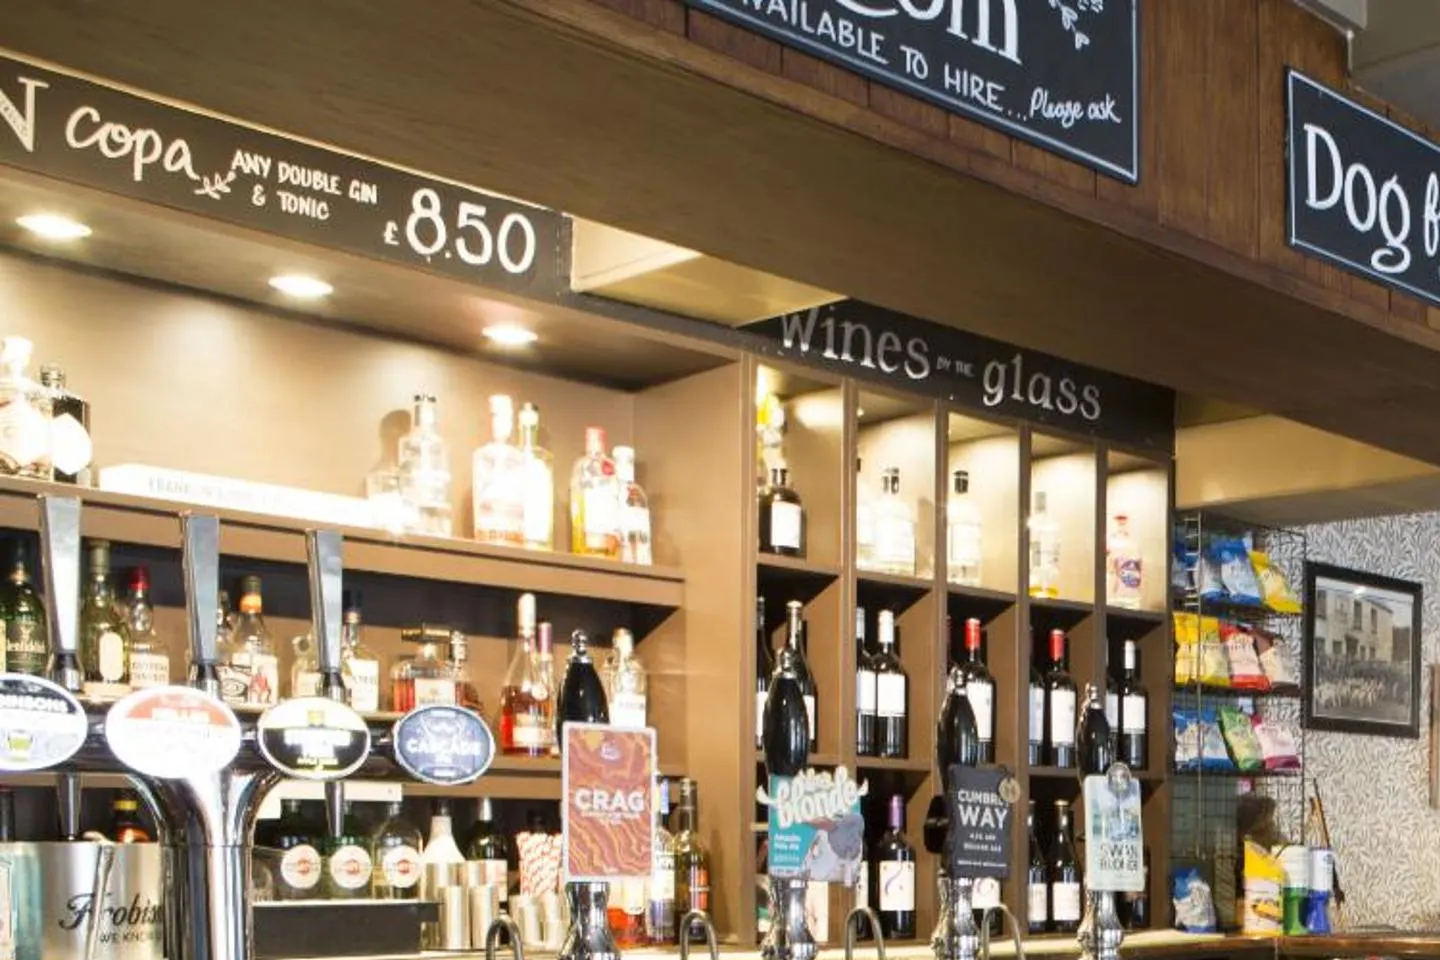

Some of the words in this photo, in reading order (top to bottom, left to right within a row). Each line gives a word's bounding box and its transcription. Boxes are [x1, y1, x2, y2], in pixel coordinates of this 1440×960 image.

[741, 0, 889, 65] AILABLE
[900, 44, 928, 79] TO
[1029, 86, 1084, 129] Please
[1087, 92, 1122, 124] ask
[65, 105, 200, 182] copa
[231, 149, 272, 179] ANY
[277, 160, 343, 196] DOUBLE
[348, 179, 378, 205] GIN
[251, 183, 266, 207] &
[276, 189, 330, 220] TONIC
[1303, 122, 1411, 274] Dog
[781, 304, 931, 380] Wines
[936, 355, 952, 371] BY
[955, 360, 977, 378] THE
[982, 354, 1102, 420] glass
[574, 787, 645, 812] CRAG
[958, 803, 1009, 830] WAY
